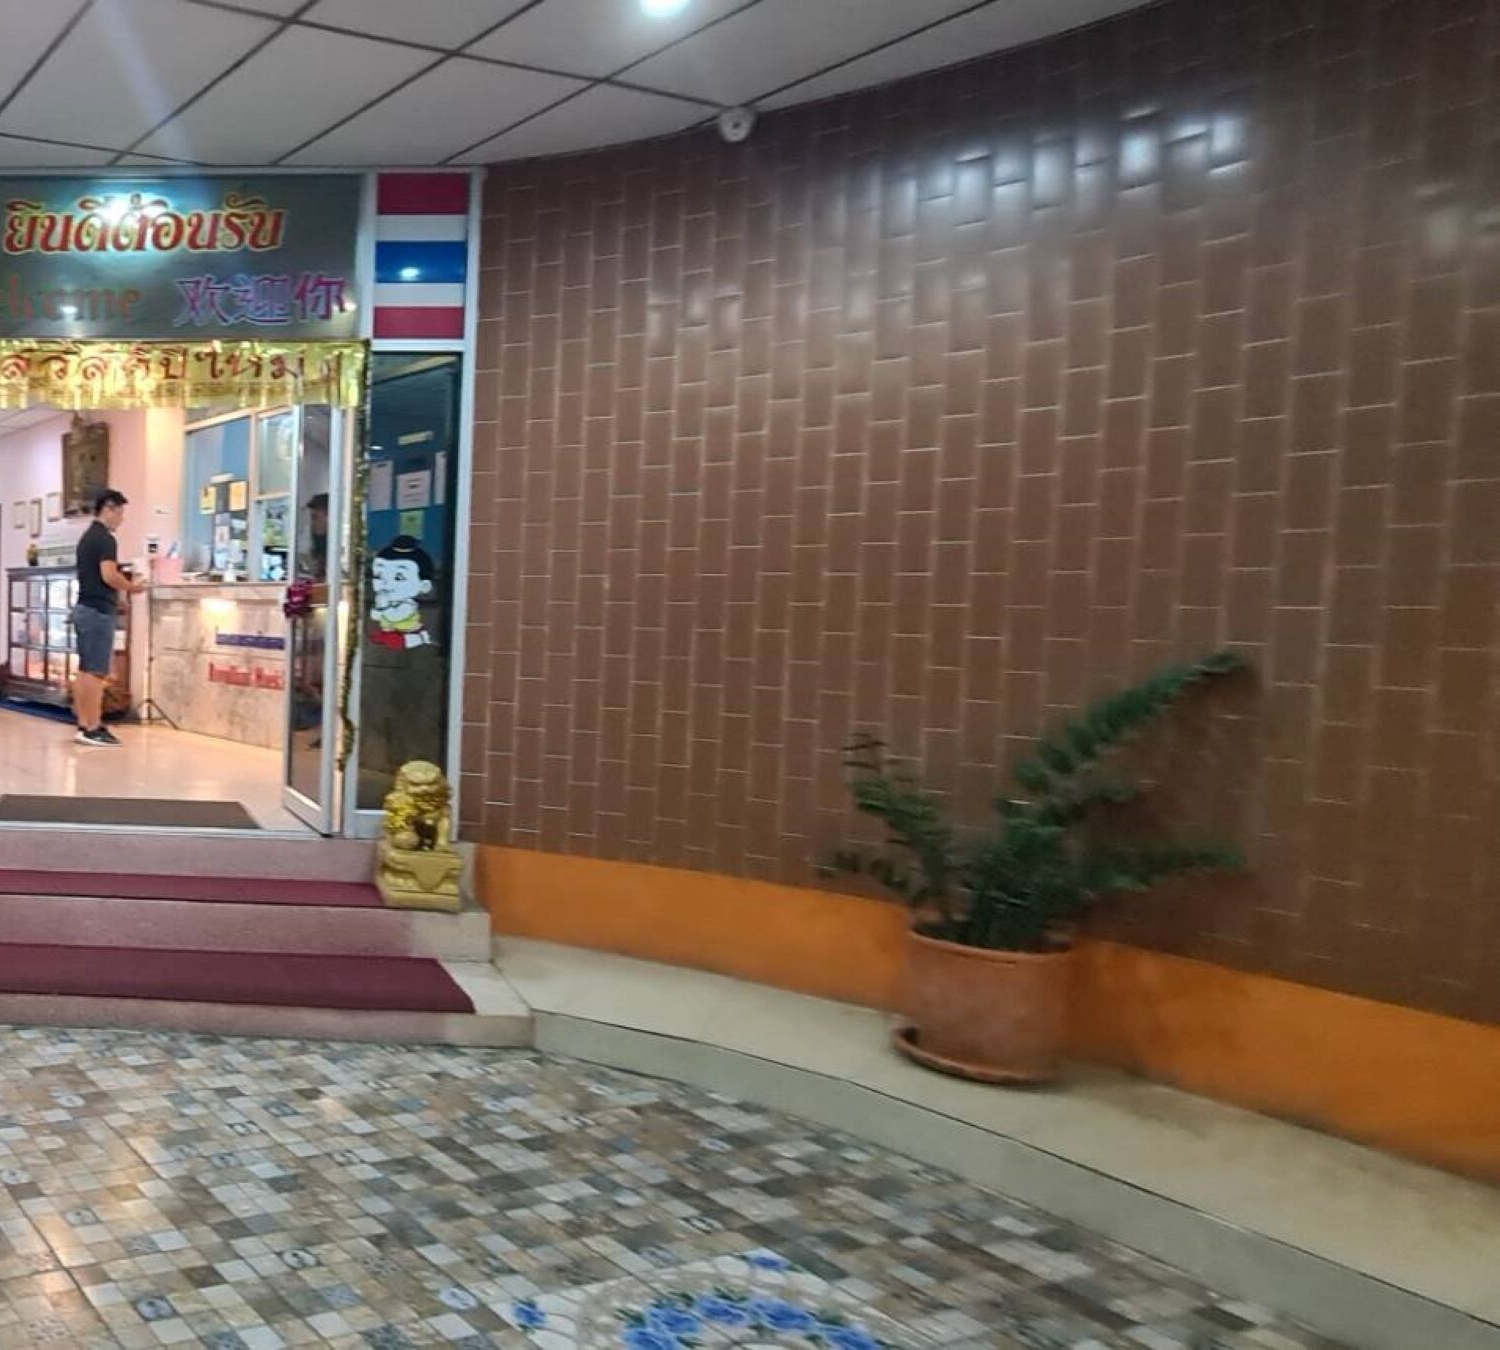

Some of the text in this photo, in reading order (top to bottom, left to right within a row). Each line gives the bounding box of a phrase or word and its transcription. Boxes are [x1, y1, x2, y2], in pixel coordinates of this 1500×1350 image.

[3, 192, 287, 255] ยินดีต้อนรับ
